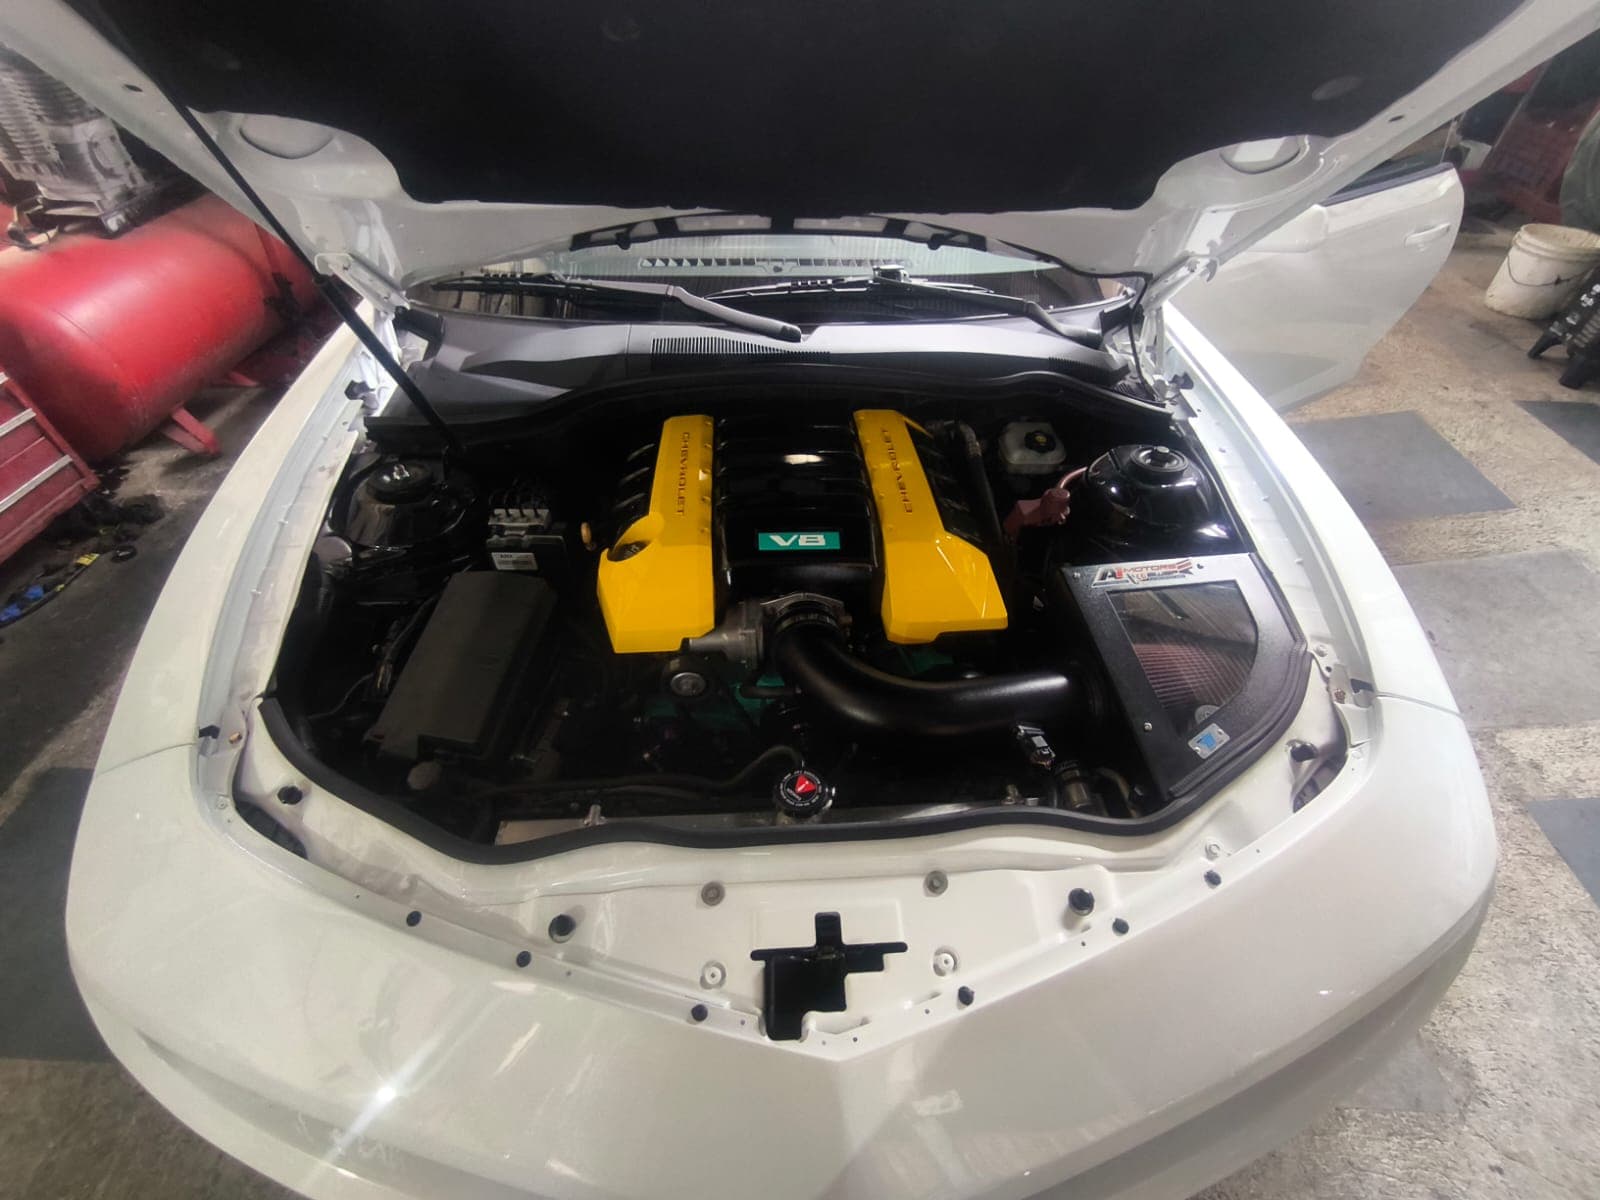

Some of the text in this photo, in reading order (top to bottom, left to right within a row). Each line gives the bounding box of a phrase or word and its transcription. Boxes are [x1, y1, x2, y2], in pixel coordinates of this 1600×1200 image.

[676, 431, 690, 516] CHEVROLET
[880, 427, 913, 514] CHEVROLET
[769, 534, 826, 547] V8
